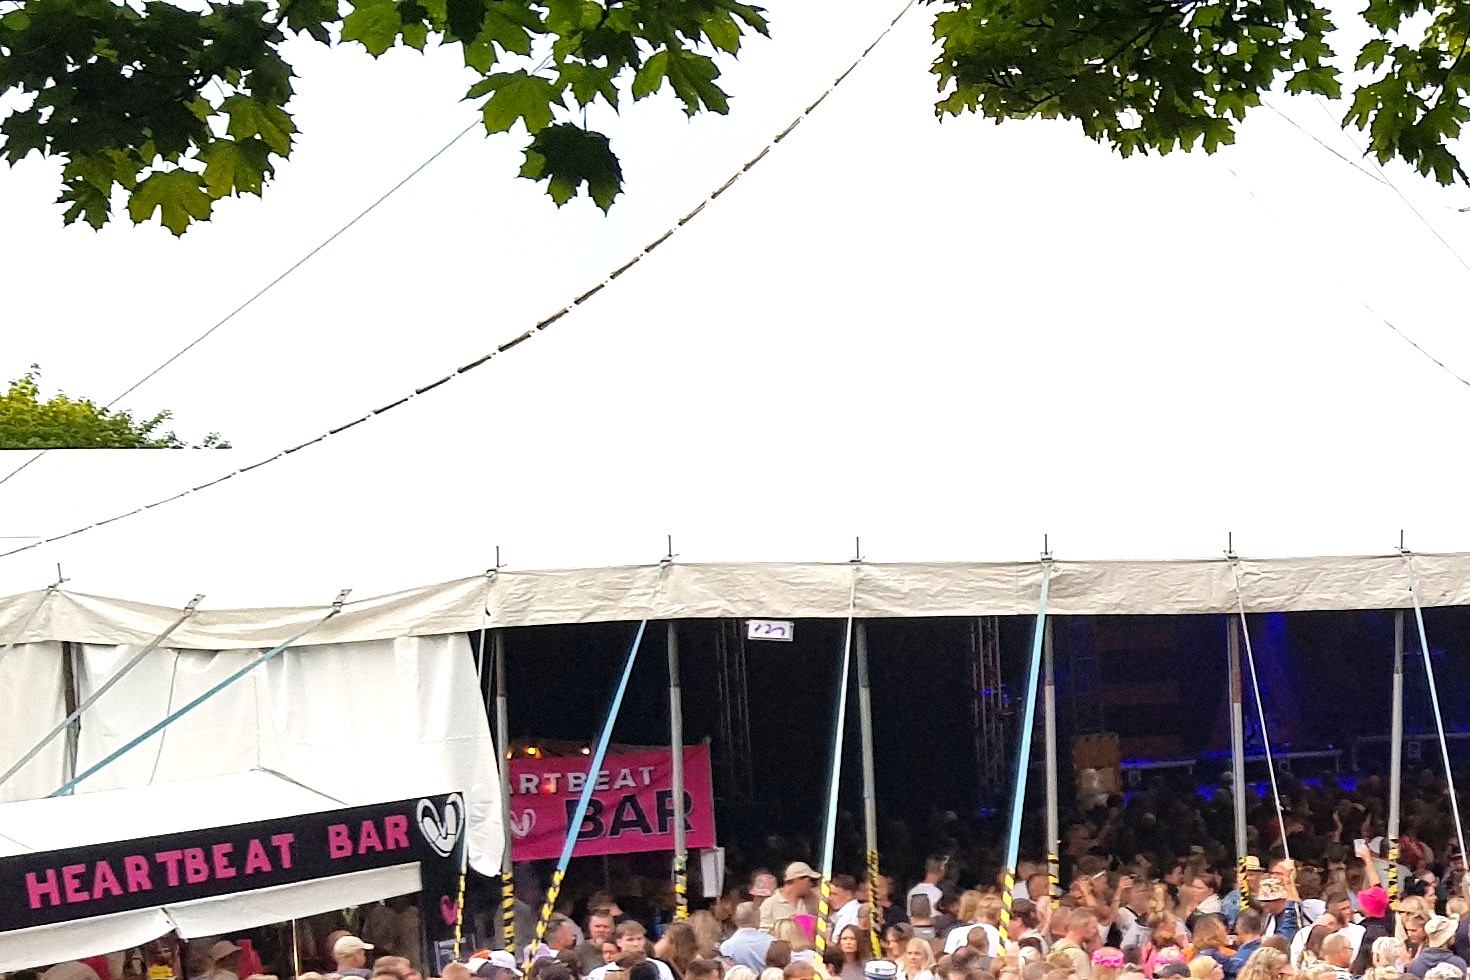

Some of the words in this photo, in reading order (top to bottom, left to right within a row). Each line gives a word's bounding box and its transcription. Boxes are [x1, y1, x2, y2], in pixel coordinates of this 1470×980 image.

[565, 790, 694, 840] BAR
[24, 833, 295, 910] HEARTBEAT
[327, 814, 410, 859] BAR
